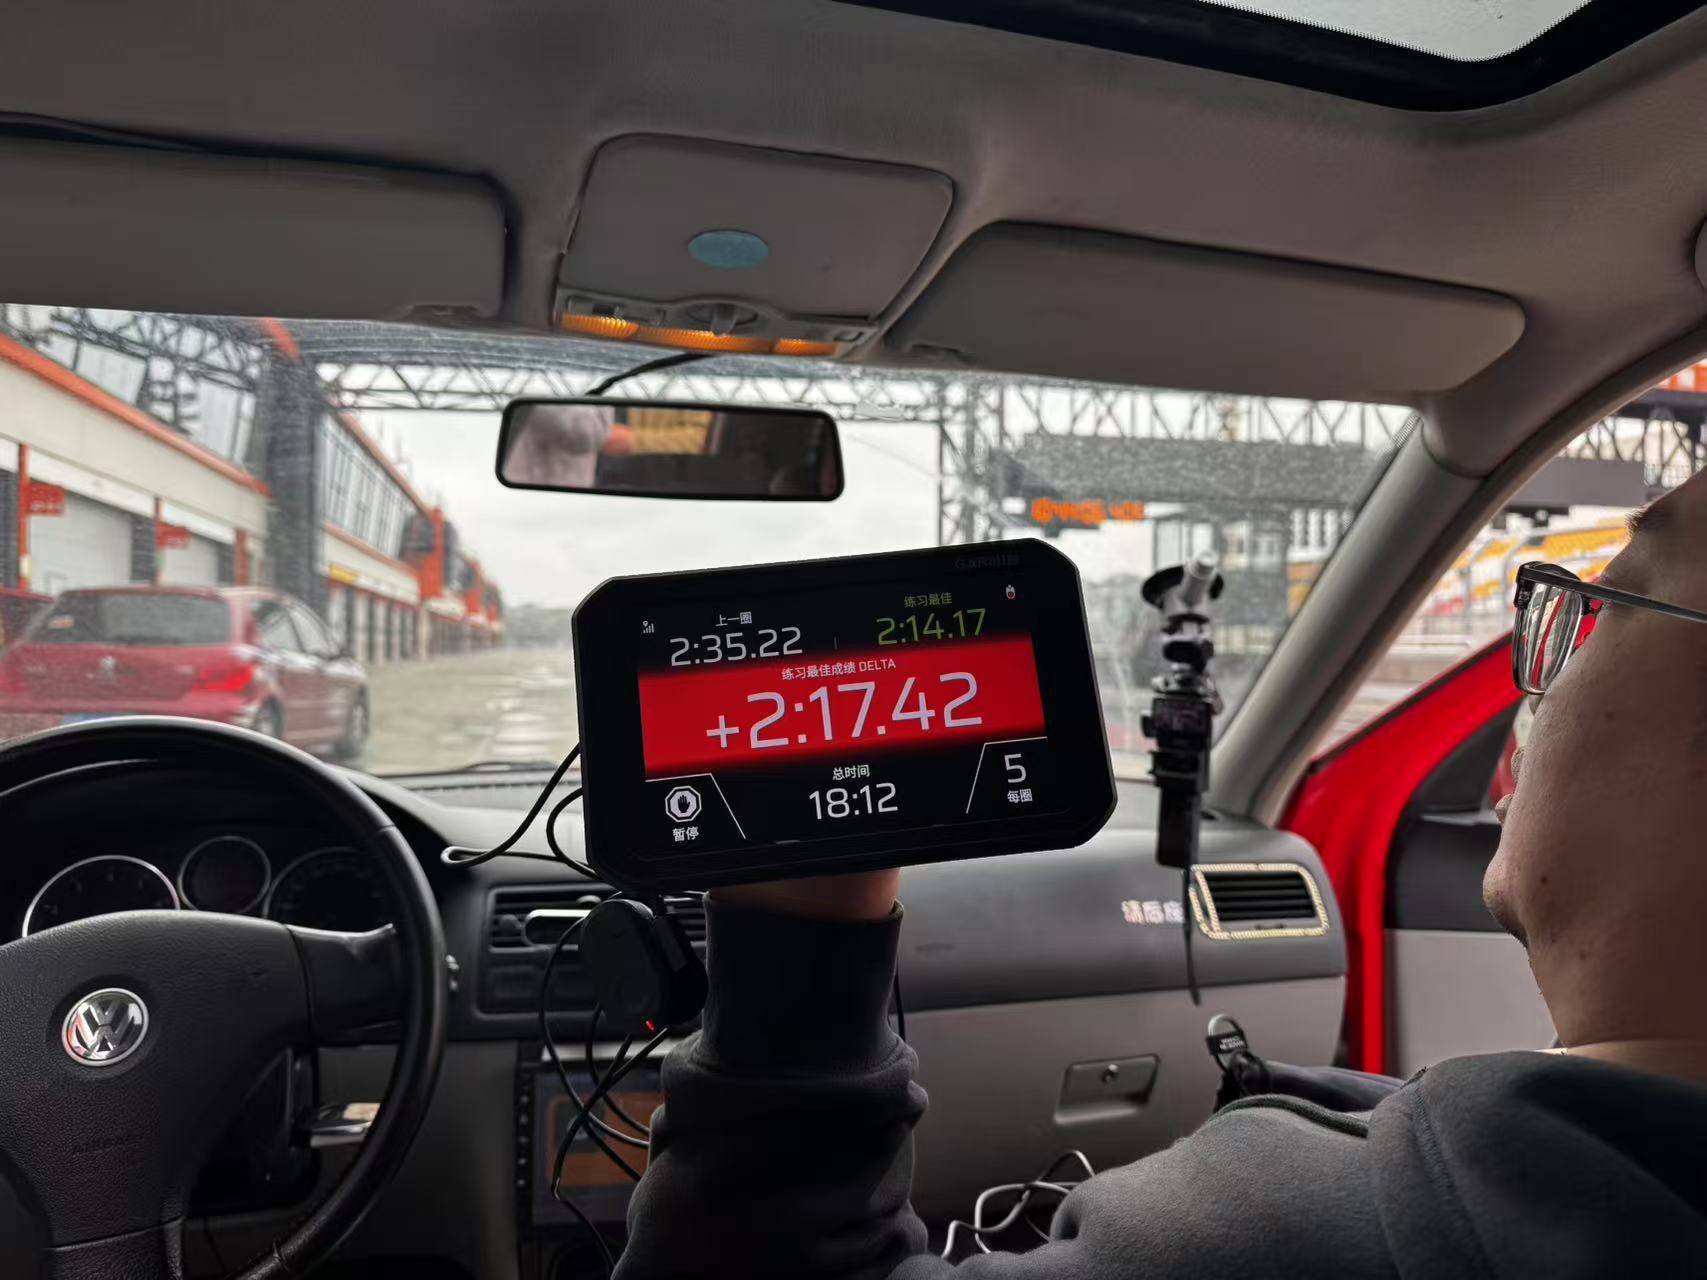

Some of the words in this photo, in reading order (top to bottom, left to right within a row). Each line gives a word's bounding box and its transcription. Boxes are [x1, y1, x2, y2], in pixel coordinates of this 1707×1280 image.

[903, 592, 953, 609] 练习最佳
[715, 611, 752, 627] 上一圈
[876, 608, 986, 646] 2:14.17
[669, 626, 802, 666] 2:35.22
[781, 661, 857, 681] 练习最佳成绩
[859, 658, 896, 673] DELTA
[706, 671, 983, 749] +2:17.42
[832, 764, 870, 781] 总时间
[1004, 753, 1026, 784] 5
[809, 782, 899, 820] 18:12
[1006, 788, 1033, 804] 每圈
[672, 826, 699, 842] 暂停
